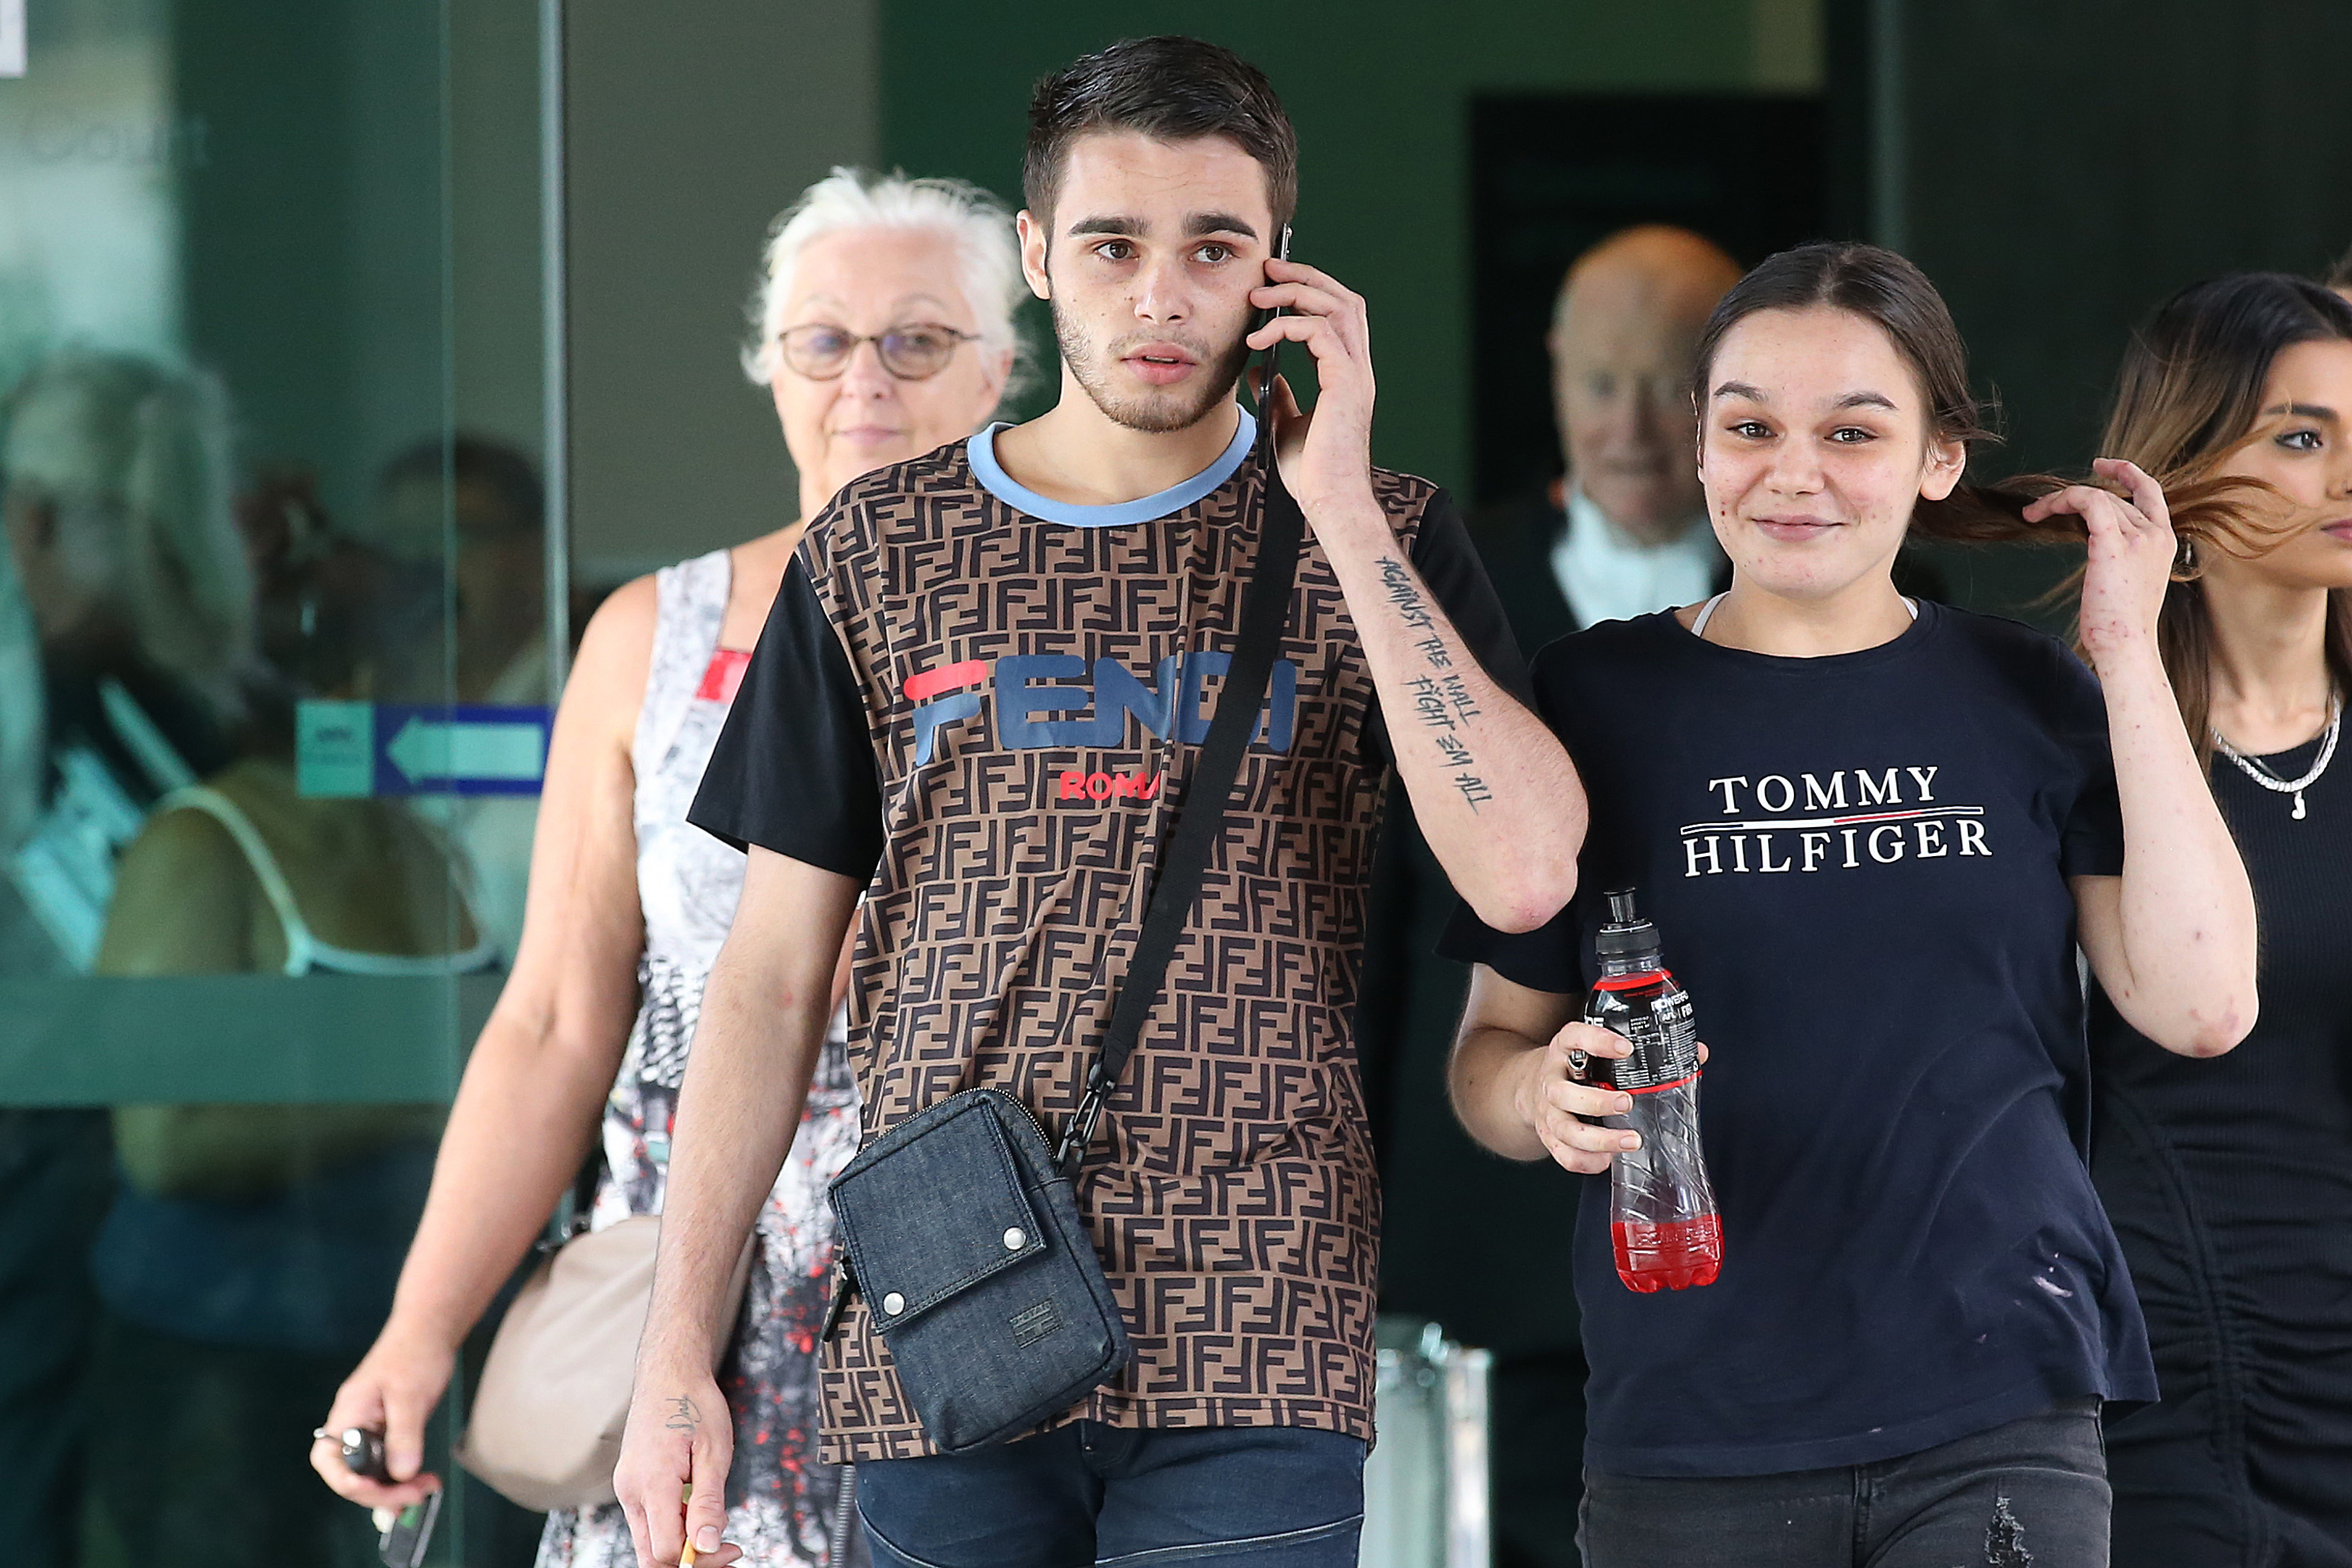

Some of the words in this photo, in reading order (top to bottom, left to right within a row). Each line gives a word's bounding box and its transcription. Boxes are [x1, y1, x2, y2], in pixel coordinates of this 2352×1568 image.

[1414, 631, 1452, 670] THE
[1441, 674, 1480, 728] WALL
[1436, 734, 1473, 768] EM
[1452, 772, 1492, 815] ALL
[1708, 766, 1939, 814] TOMMY
[1682, 819, 1993, 877] HILFIGER
